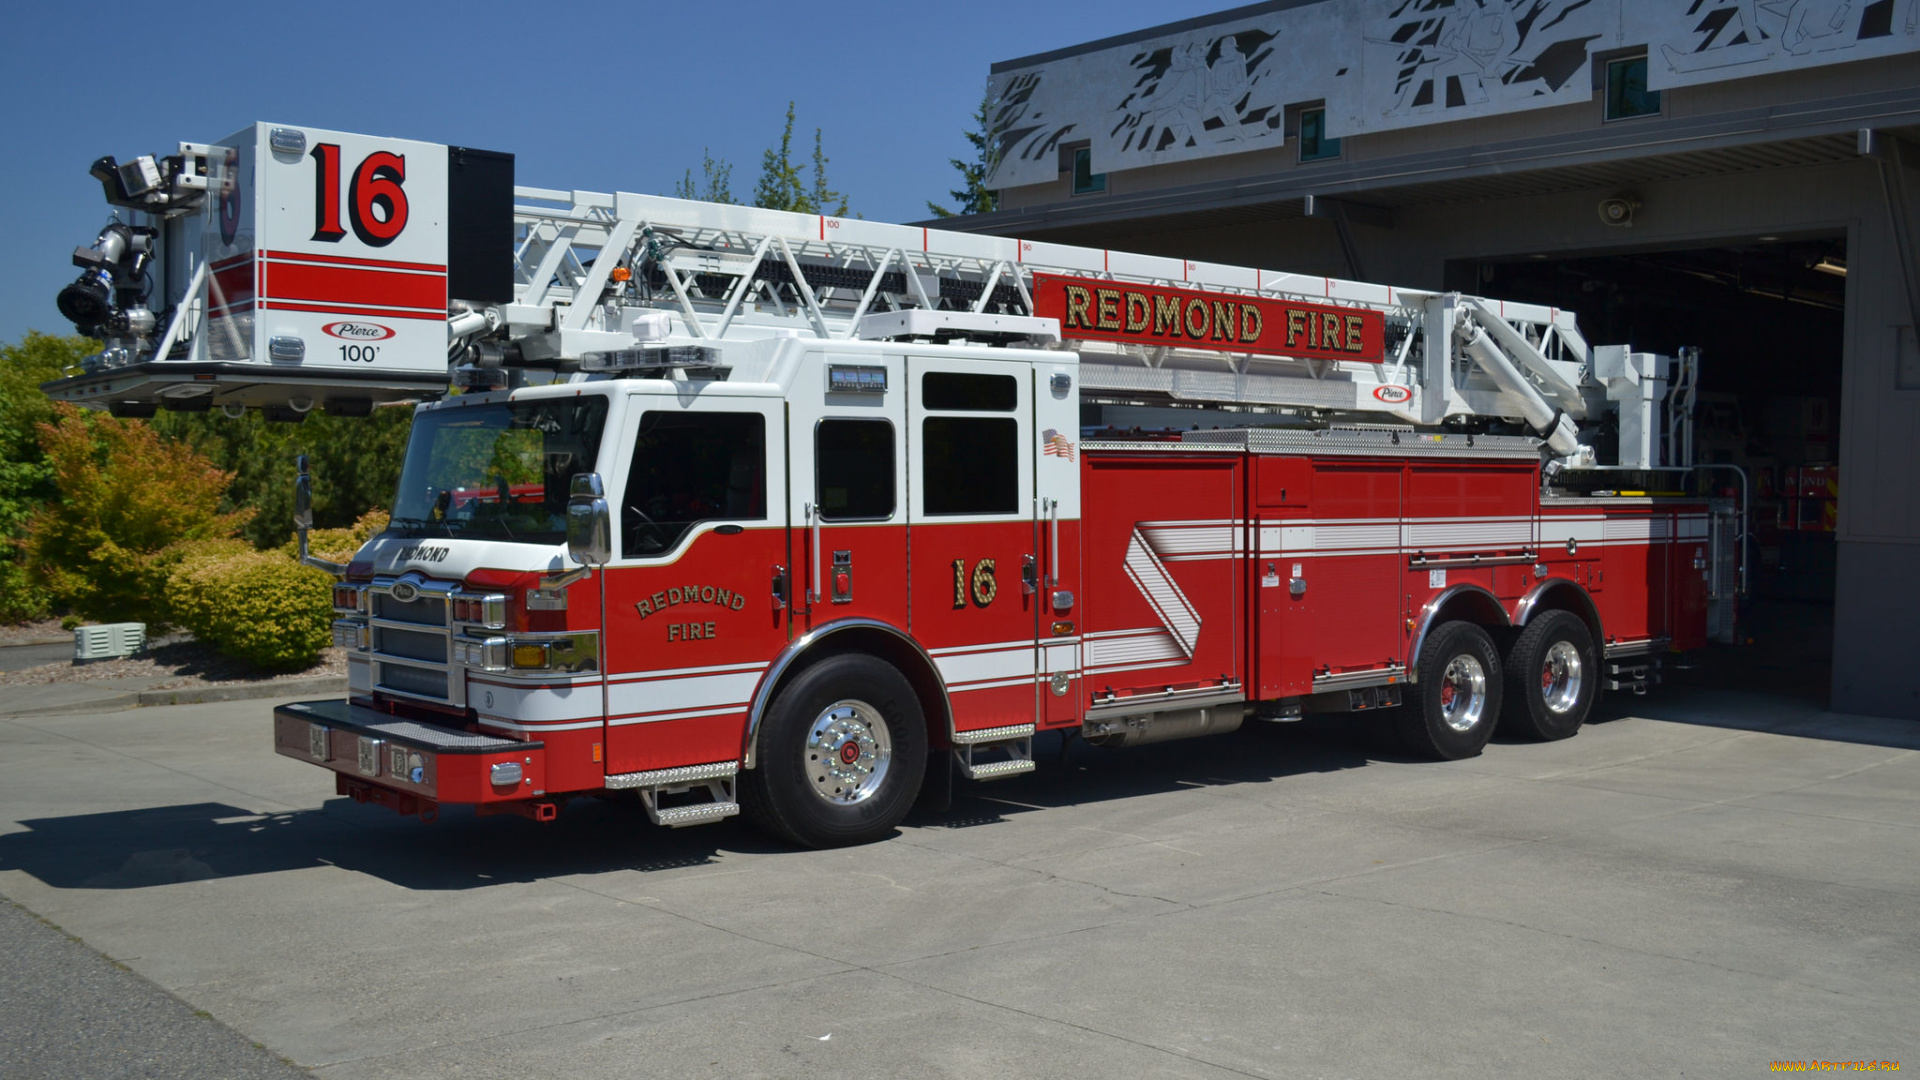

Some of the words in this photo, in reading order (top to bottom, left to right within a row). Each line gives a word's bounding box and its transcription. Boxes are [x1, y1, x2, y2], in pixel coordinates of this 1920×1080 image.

[309, 142, 409, 248] 16
[826, 219, 840, 230] 100
[1022, 243, 1032, 252] 90
[1188, 263, 1196, 271] 80
[1329, 281, 1336, 289] 70
[1064, 285, 1262, 343] REDMOND
[1285, 309, 1364, 353] FIRE
[338, 323, 379, 337] Pierce
[339, 345, 380, 362] 100'
[1381, 387, 1404, 399] Pierce
[951, 558, 998, 610] 16
[635, 584, 746, 620] REDMOND
[667, 621, 716, 643] FIRE
